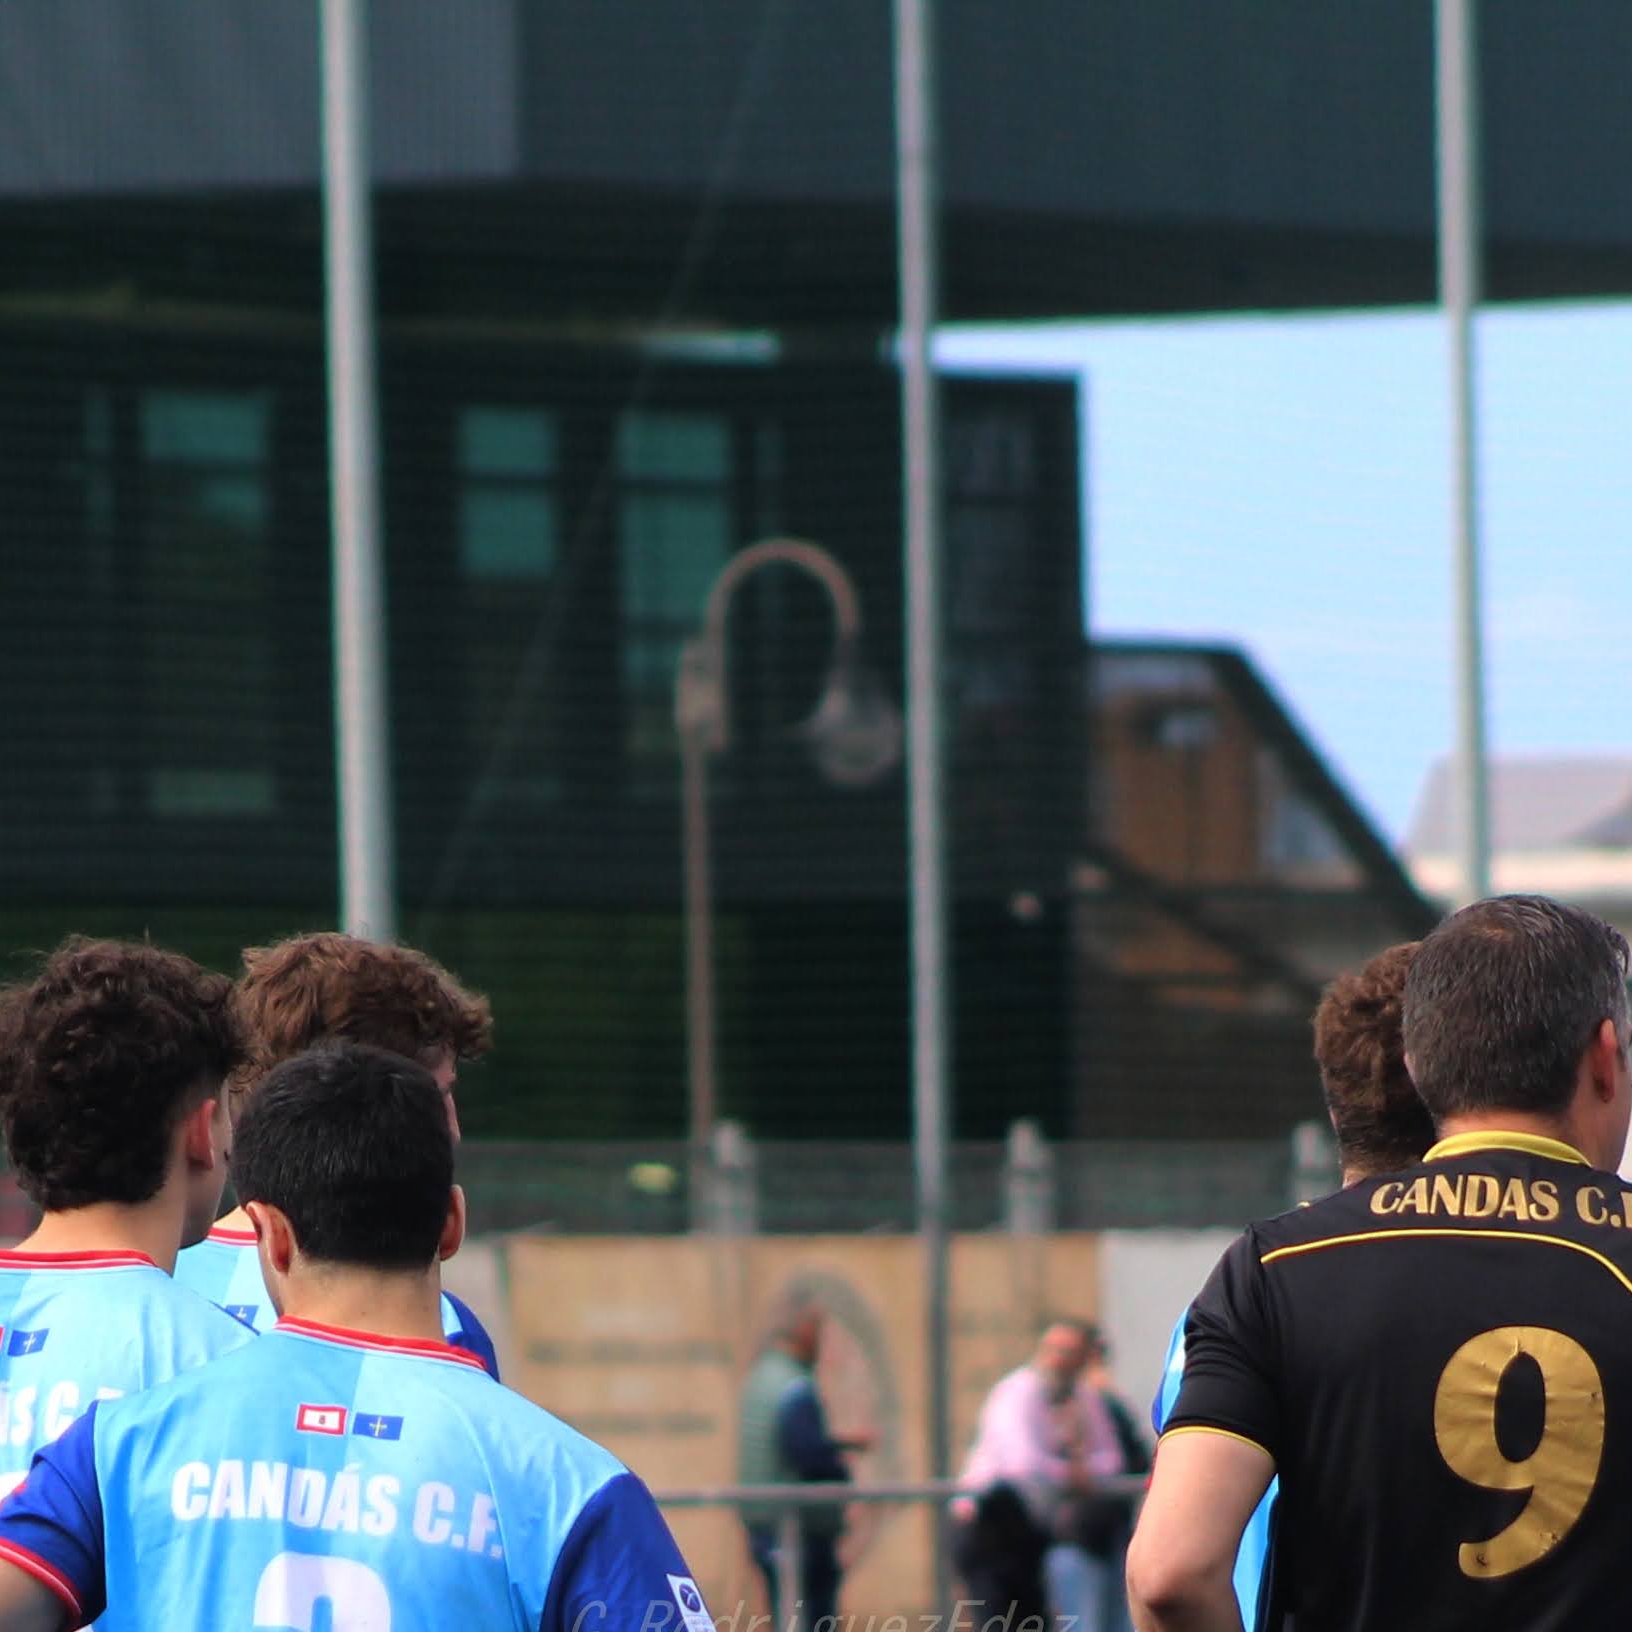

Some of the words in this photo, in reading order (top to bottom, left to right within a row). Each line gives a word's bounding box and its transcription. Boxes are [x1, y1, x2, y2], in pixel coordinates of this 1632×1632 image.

[1370, 1173, 1560, 1222] CANDAS
[1433, 1326, 1606, 1580] 9
[171, 1459, 400, 1537] CANDÁS
[413, 1481, 505, 1558] C.F.
